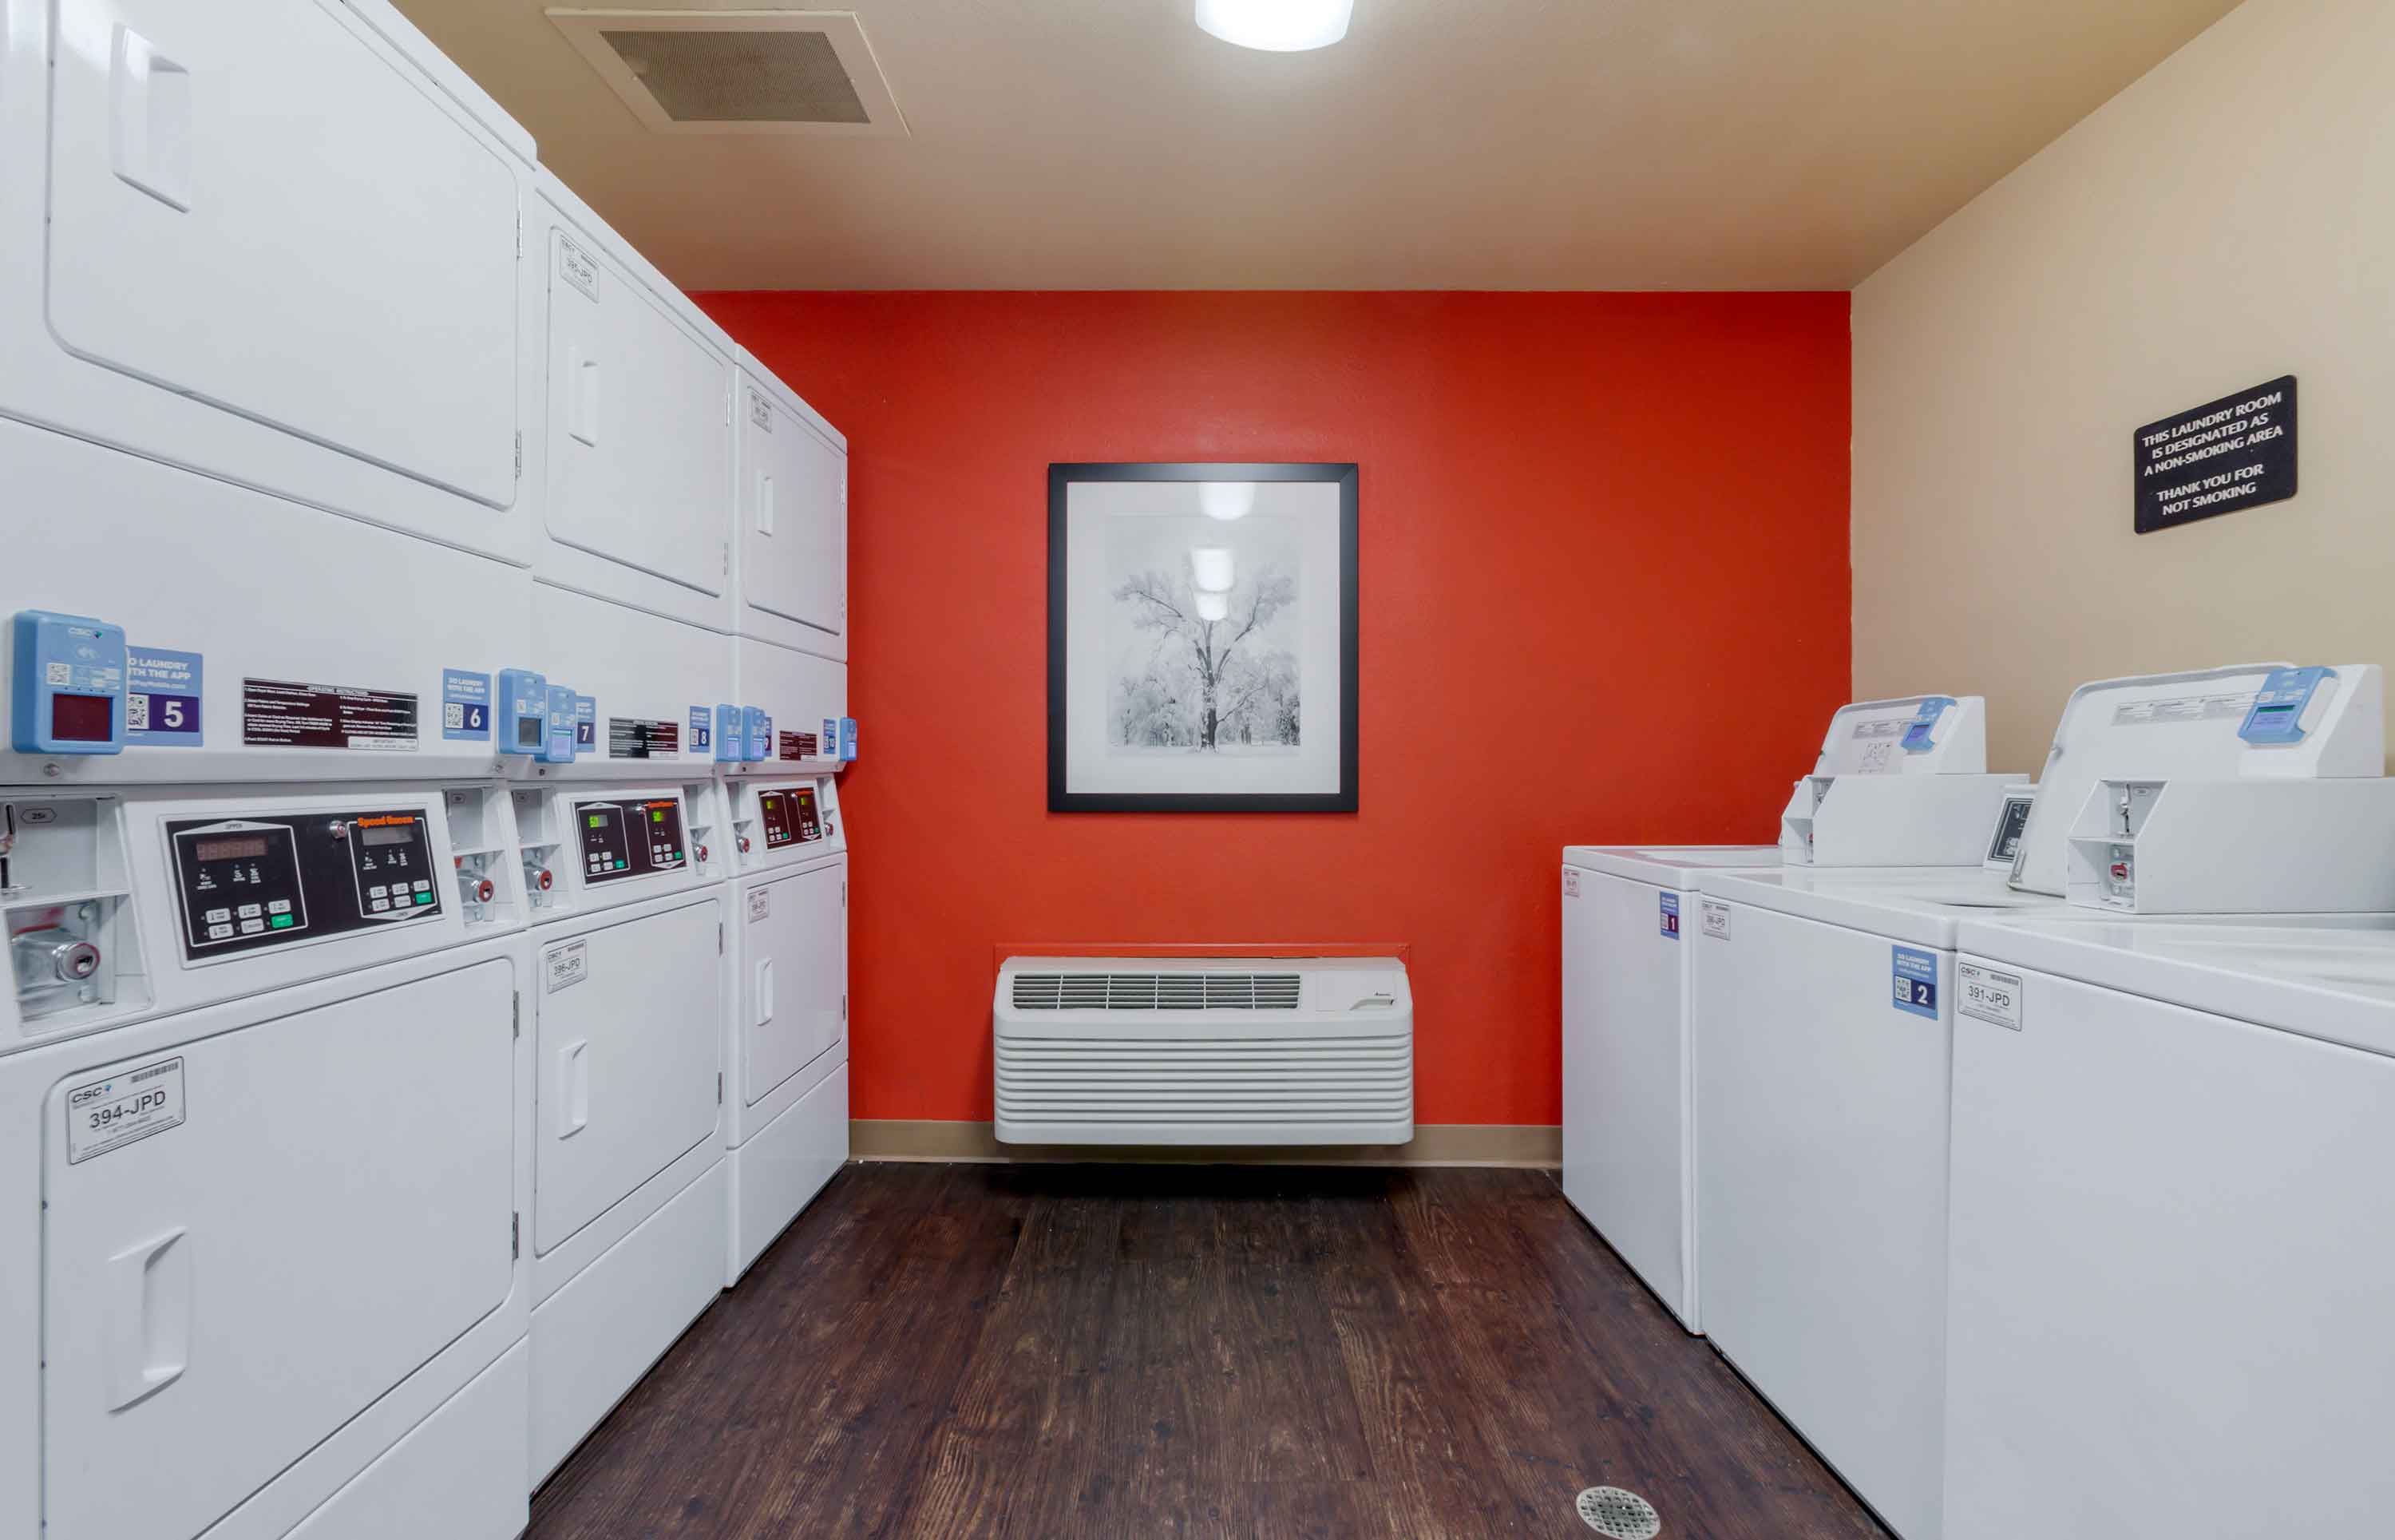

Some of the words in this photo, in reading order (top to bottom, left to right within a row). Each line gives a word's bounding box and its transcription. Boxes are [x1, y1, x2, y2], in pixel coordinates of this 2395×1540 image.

[2142, 431, 2170, 447] THIS
[2171, 408, 2235, 437] LAUNDRY
[2235, 391, 2282, 416] ROOM
[2152, 449, 2163, 460] IS
[2165, 420, 2247, 455] DESIGNATED
[2250, 413, 2270, 428] AS
[2144, 465, 2153, 477] A
[2155, 437, 2245, 473] NON-SMOKING
[2247, 426, 2284, 445] AREA
[2157, 481, 2202, 502] THANK
[2202, 472, 2232, 489] YOU
[2235, 464, 2265, 481] FOR
[2162, 499, 2191, 516] NOT
[2192, 481, 2258, 508] SMOKING
[140, 658, 190, 671] LAUNDRY
[148, 668, 168, 679] THE
[169, 671, 191, 681] APP
[164, 700, 184, 728] 5
[469, 708, 481, 728] 6
[580, 725, 590, 742] 7
[701, 730, 707, 745] 8
[357, 817, 386, 829] Speed
[386, 815, 414, 825] Queen
[1669, 917, 1676, 930] 1
[1917, 985, 1929, 1004] 2
[1967, 985, 2011, 1008] 391-JPD
[72, 1087, 103, 1103] CSC
[89, 1091, 166, 1129] 394-JPD
